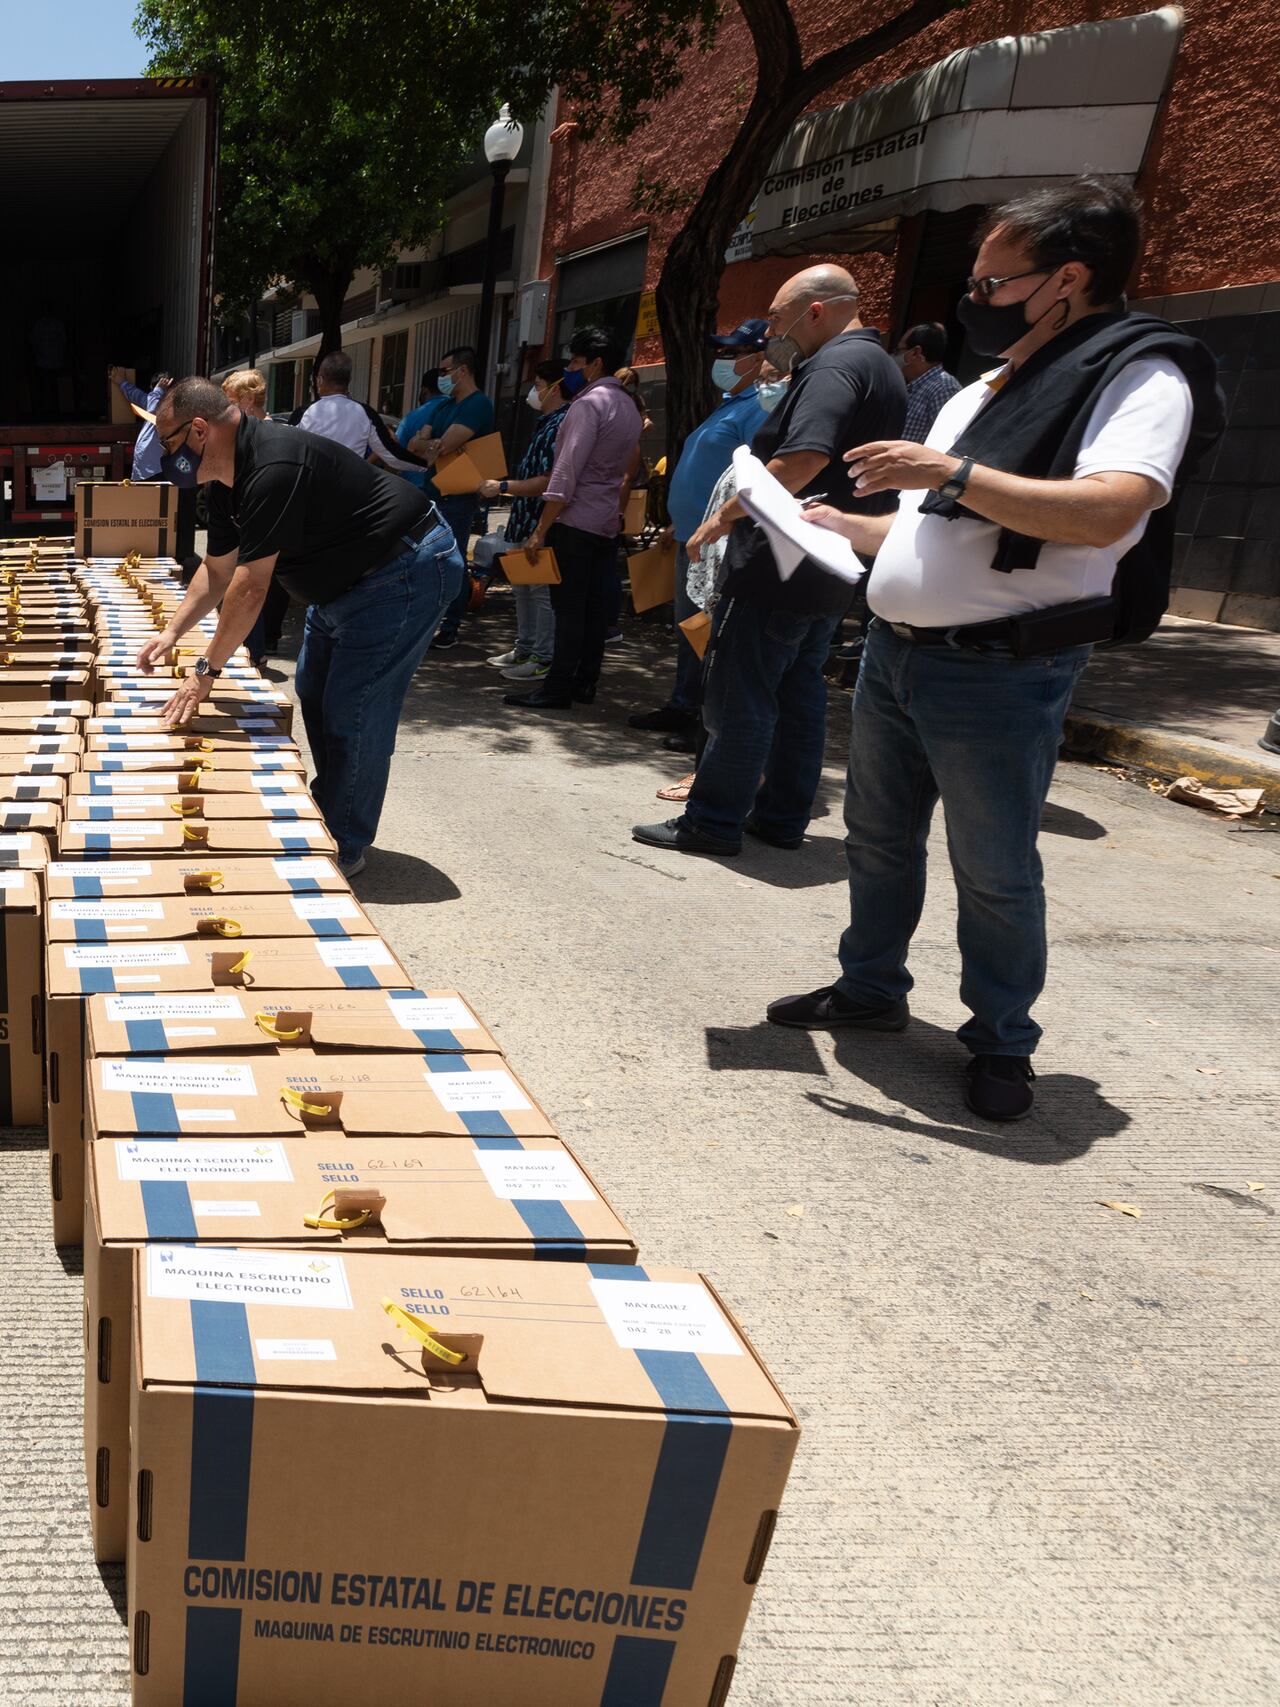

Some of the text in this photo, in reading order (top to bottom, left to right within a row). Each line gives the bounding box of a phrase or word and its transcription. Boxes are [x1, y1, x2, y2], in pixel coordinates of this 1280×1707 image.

[764, 124, 928, 196] Comisión Estatal
[822, 176, 845, 195] de
[782, 184, 884, 226] Elecciones
[83, 518, 109, 528] COMISION
[110, 518, 130, 528] ESTATAL
[139, 518, 168, 528] ELECCIONES
[318, 1162, 355, 1171] SELLO
[321, 1174, 360, 1183] SELLO
[164, 1267, 331, 1284] MAQUINA ESCRUTINIO
[400, 1287, 444, 1300] SELLO
[405, 1303, 450, 1316] SELLO
[624, 1301, 689, 1312] MAYAGUEZ
[183, 1564, 688, 1633] COMISION ESTATAL DE ELECCIONES
[254, 1618, 596, 1662] MAQUINA DE ESCRUTINIO ELECTRONICO
